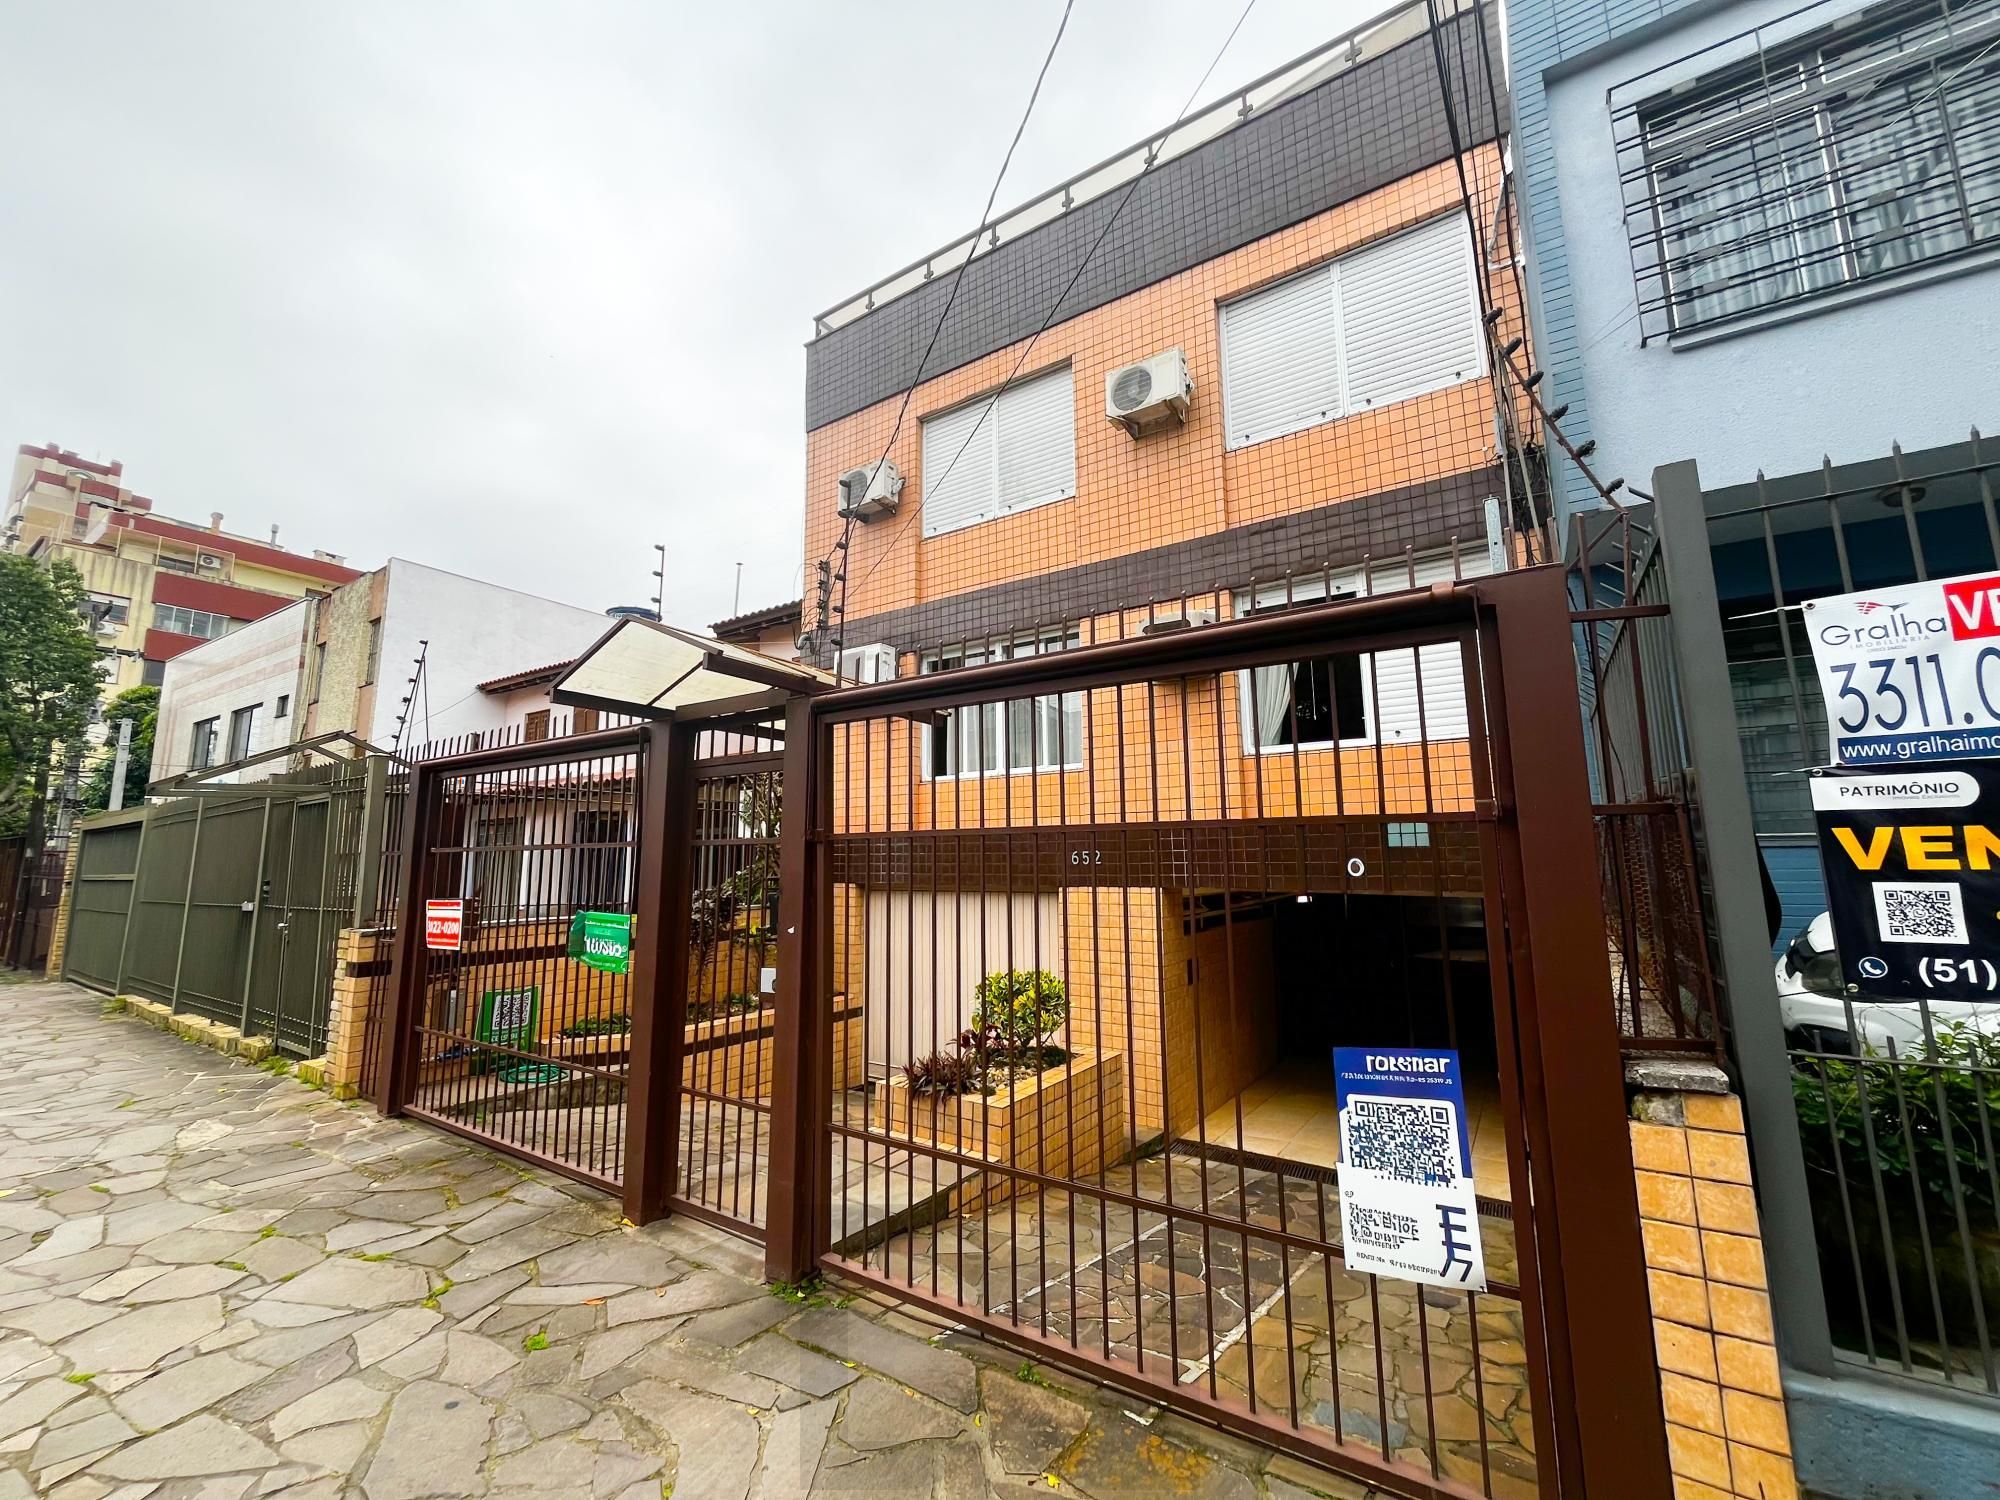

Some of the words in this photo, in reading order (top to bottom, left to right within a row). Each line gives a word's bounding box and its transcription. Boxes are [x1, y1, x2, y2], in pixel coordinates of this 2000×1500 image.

[1820, 613, 1947, 646] Gralha
[1840, 782, 1960, 797] PATRIMÔNIO
[1071, 850, 1102, 865] 652
[1918, 957, 1997, 991] (51)
